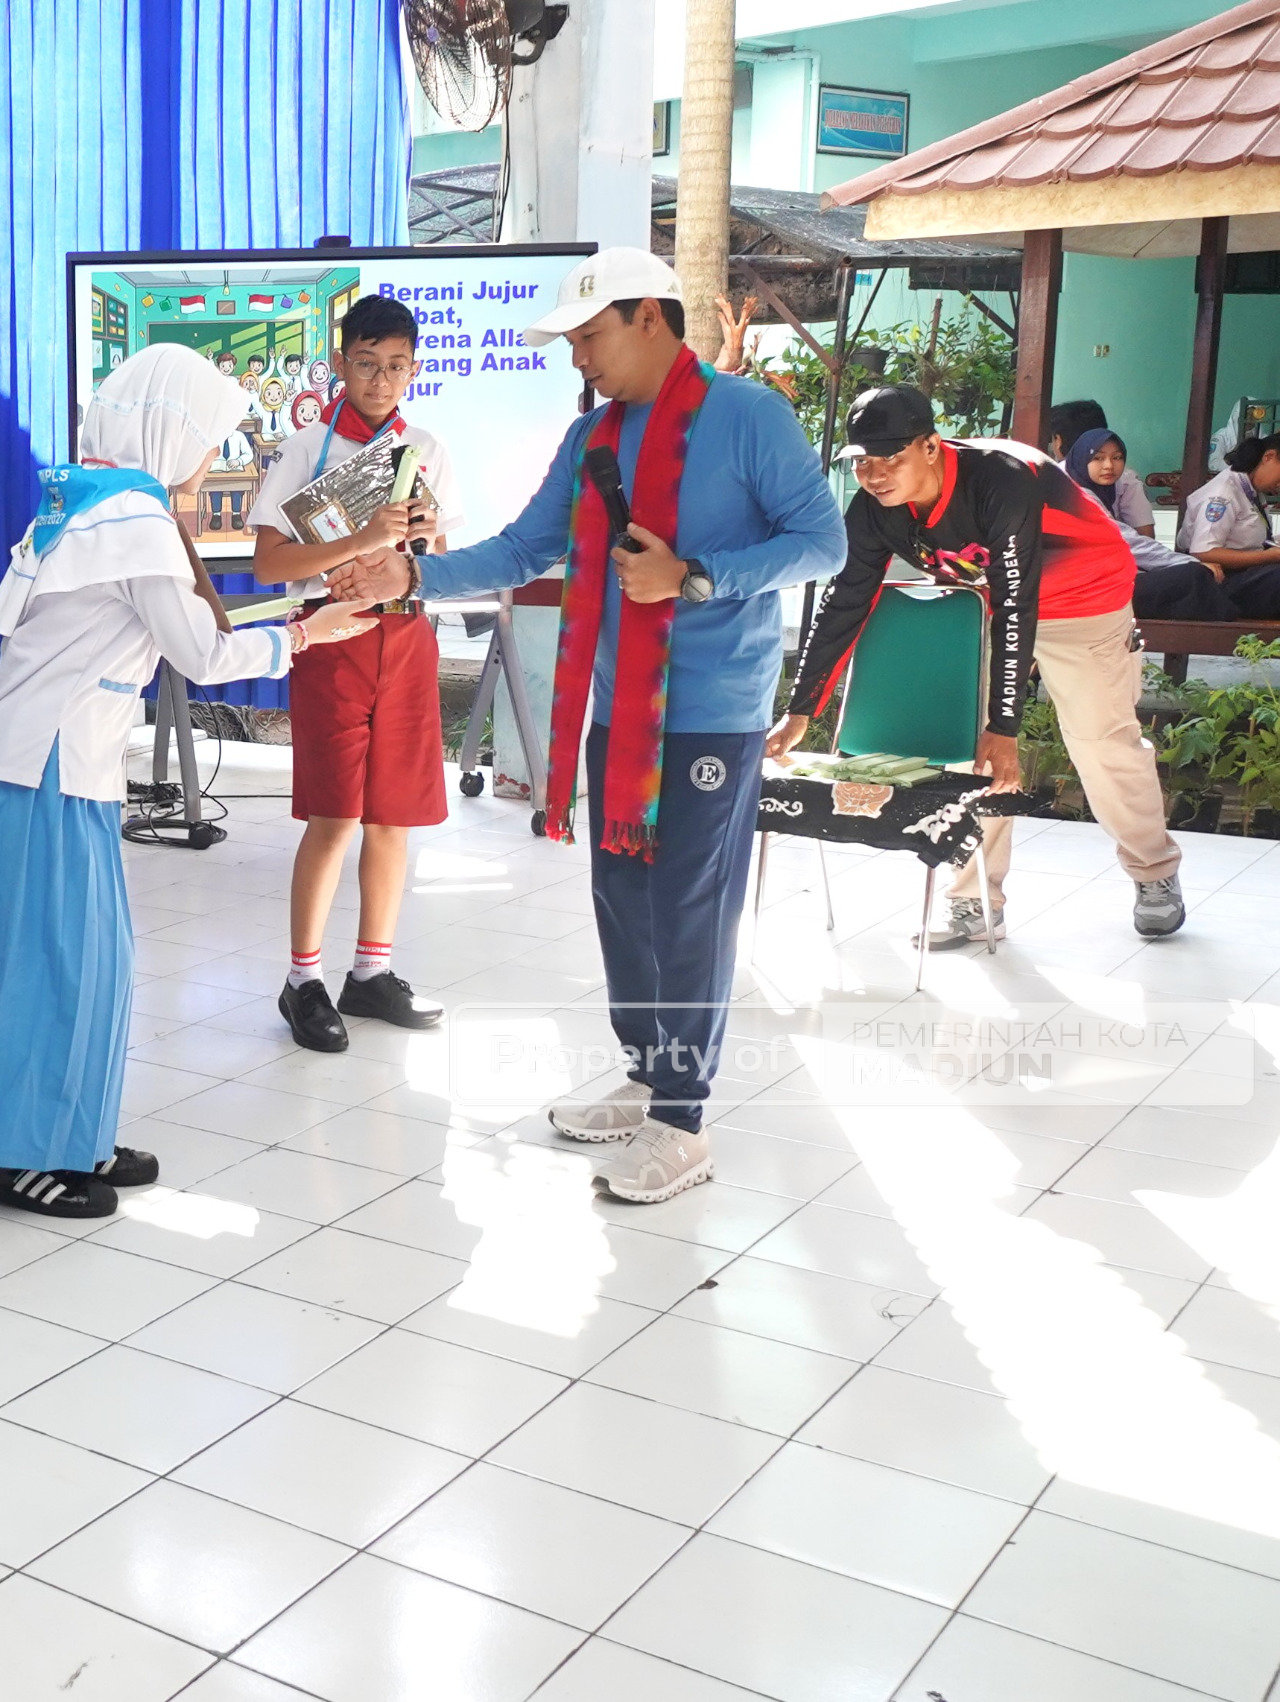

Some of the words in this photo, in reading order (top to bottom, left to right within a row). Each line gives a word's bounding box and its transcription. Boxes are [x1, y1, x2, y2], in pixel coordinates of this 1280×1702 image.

[379, 281, 463, 301] Berani
[472, 281, 539, 304] Jujur
[413, 306, 463, 328] bat,
[480, 329, 529, 348] Alla
[480, 352, 547, 371] Anak
[402, 379, 443, 402] jur
[1005, 612, 1019, 652] KOTA
[1002, 659, 1018, 717] MADIUN
